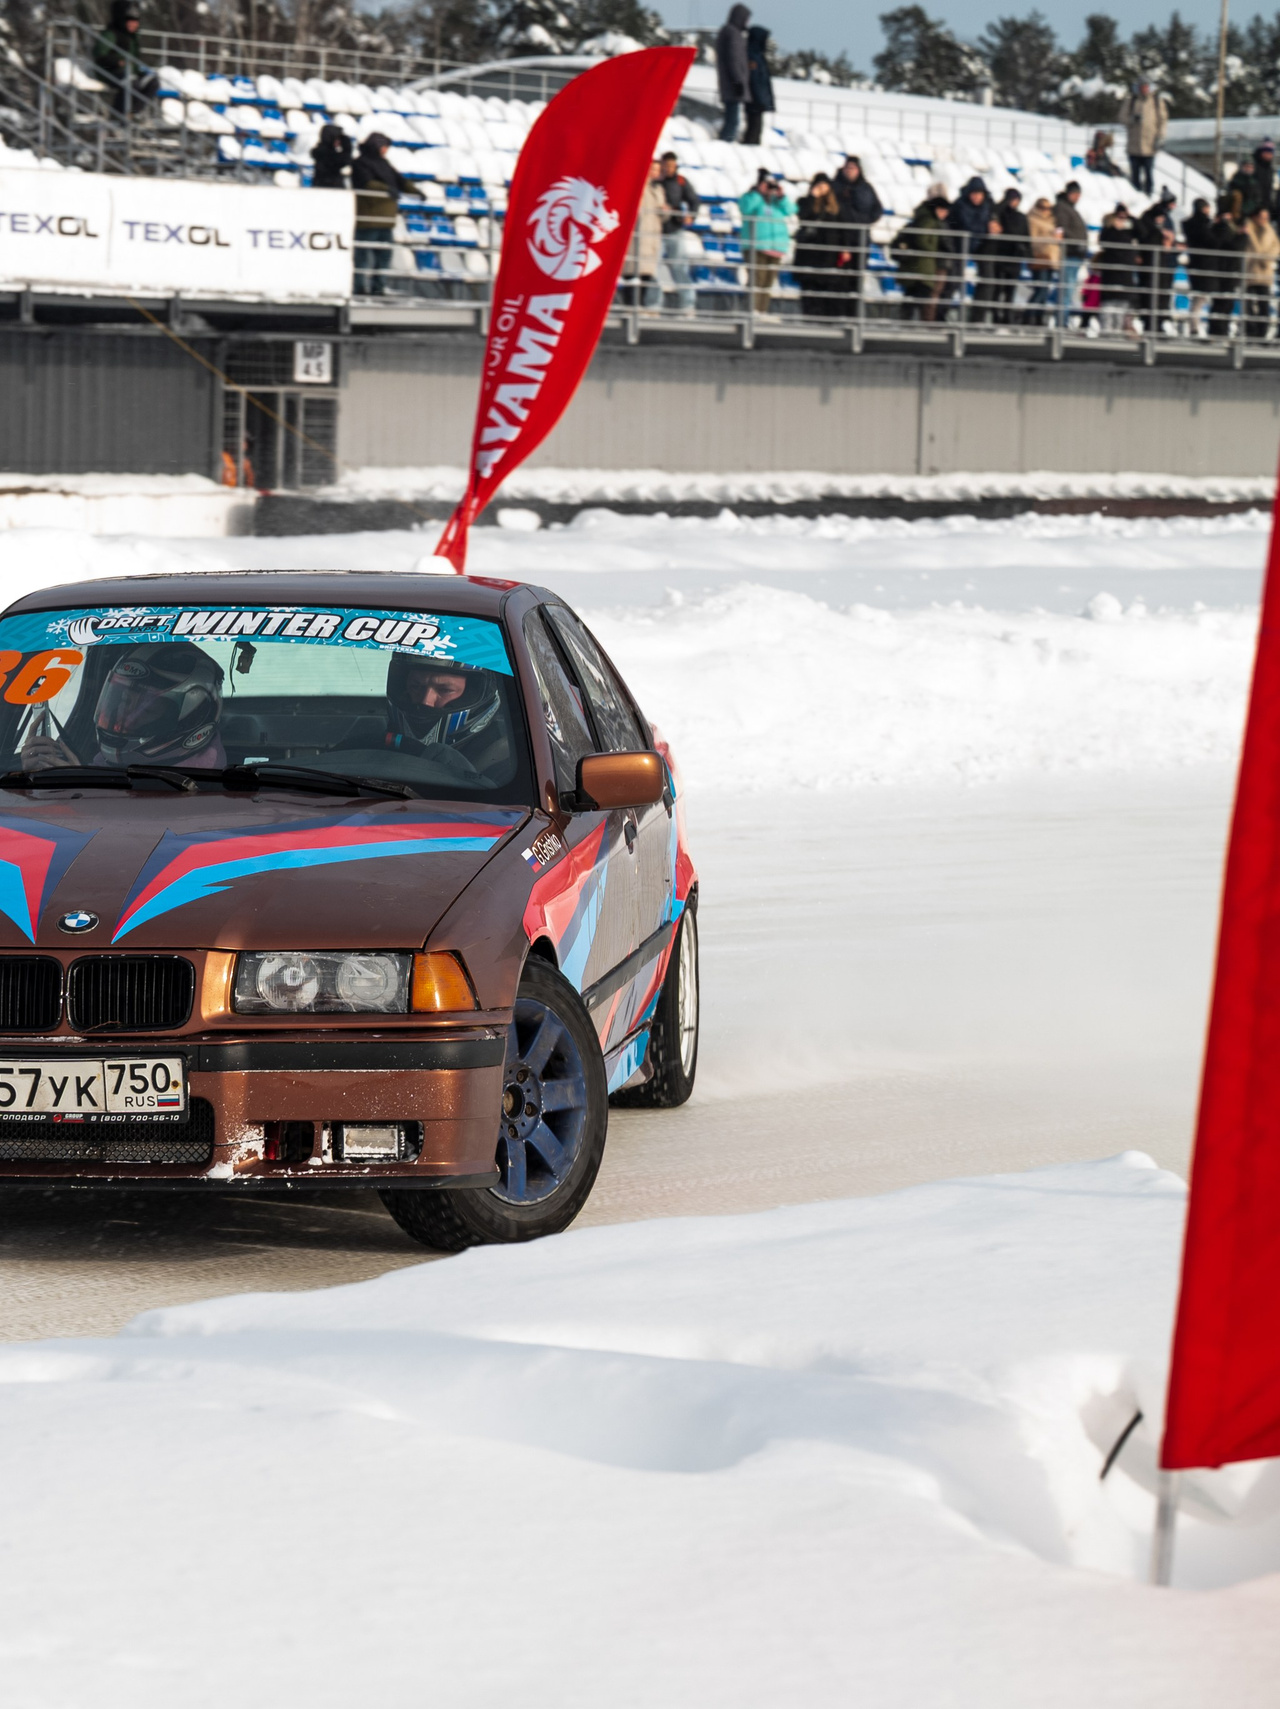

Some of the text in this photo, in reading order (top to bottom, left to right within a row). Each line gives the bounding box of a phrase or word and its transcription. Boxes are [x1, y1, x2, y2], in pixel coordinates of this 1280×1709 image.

[496, 294, 525, 332] OIL
[96, 611, 440, 646] DRIFT WINTER CUP
[129, 625, 160, 633] EXPO
[107, 1063, 171, 1095] 750
[124, 1096, 156, 1107] RUS
[100, 1114, 126, 1122] (800)
